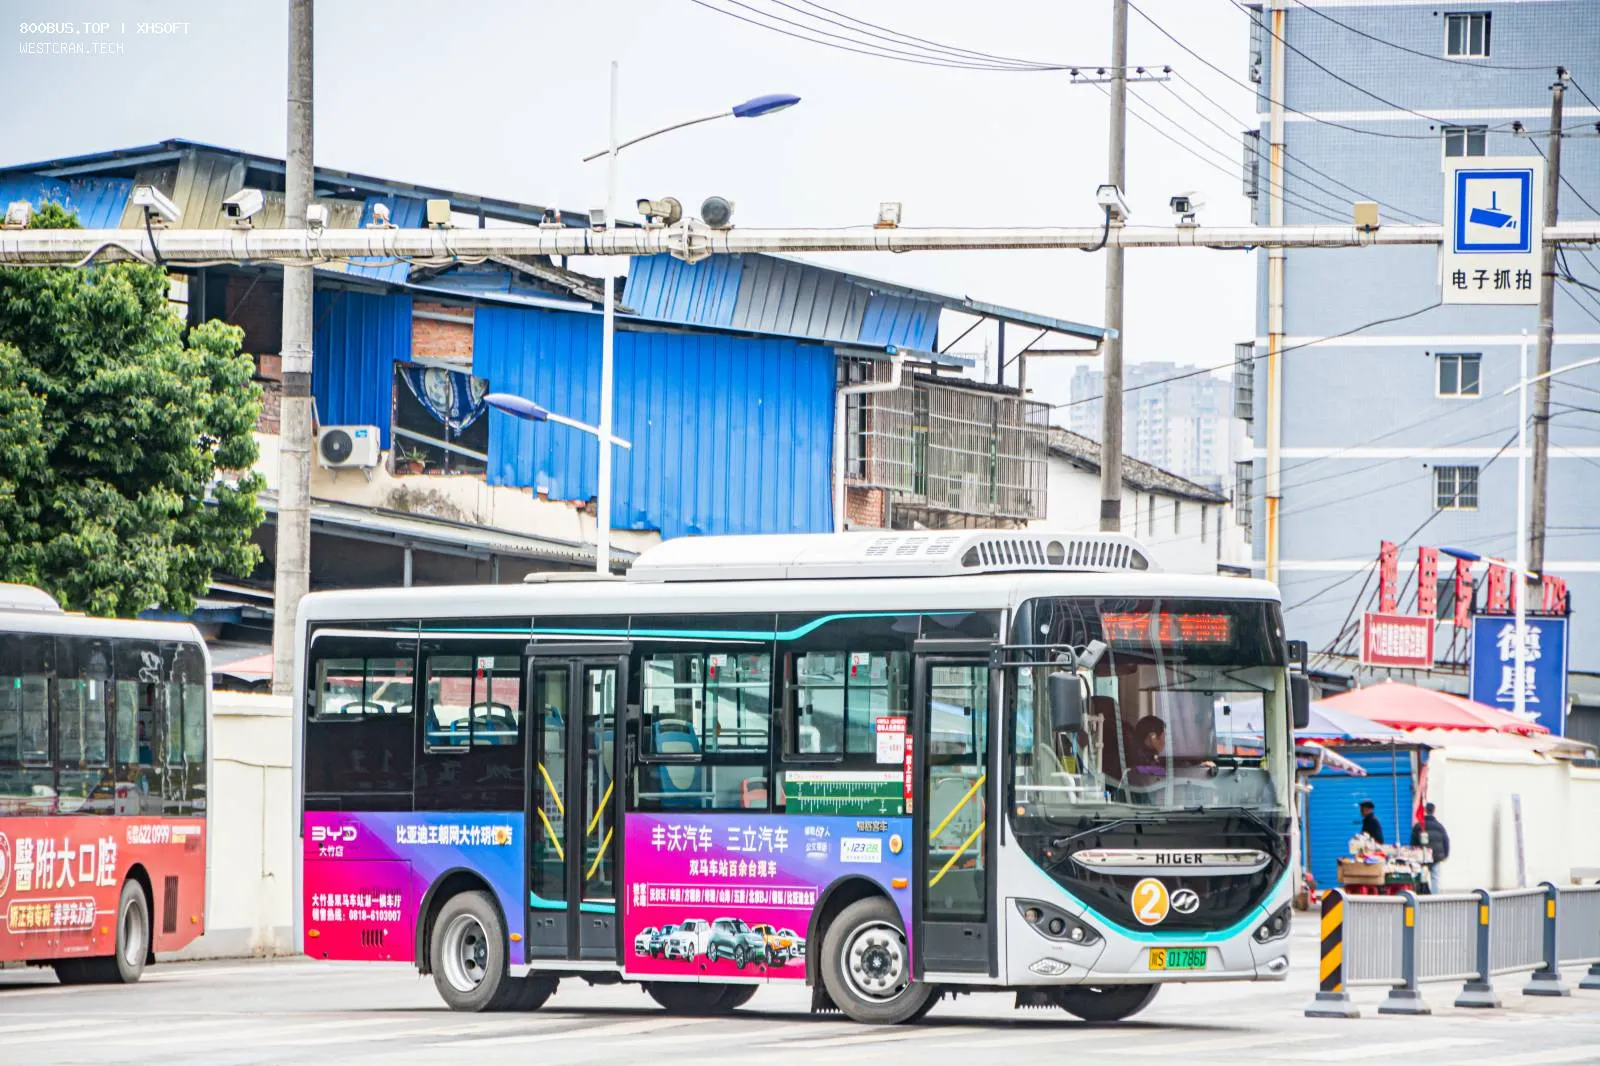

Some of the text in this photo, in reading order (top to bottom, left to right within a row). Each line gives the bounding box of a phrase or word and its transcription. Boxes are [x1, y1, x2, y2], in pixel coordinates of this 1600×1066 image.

[1452, 269, 1532, 290] 电子抓拍
[311, 826, 357, 841] BYD
[651, 824, 789, 854] 丰沃汽车 三立汽车
[319, 844, 344, 857] 大竹店
[1155, 853, 1203, 864] HIGER
[14, 836, 117, 892] 醫附大口腔
[689, 859, 777, 878] 双马车站百余台现车
[1138, 883, 1162, 920] 2
